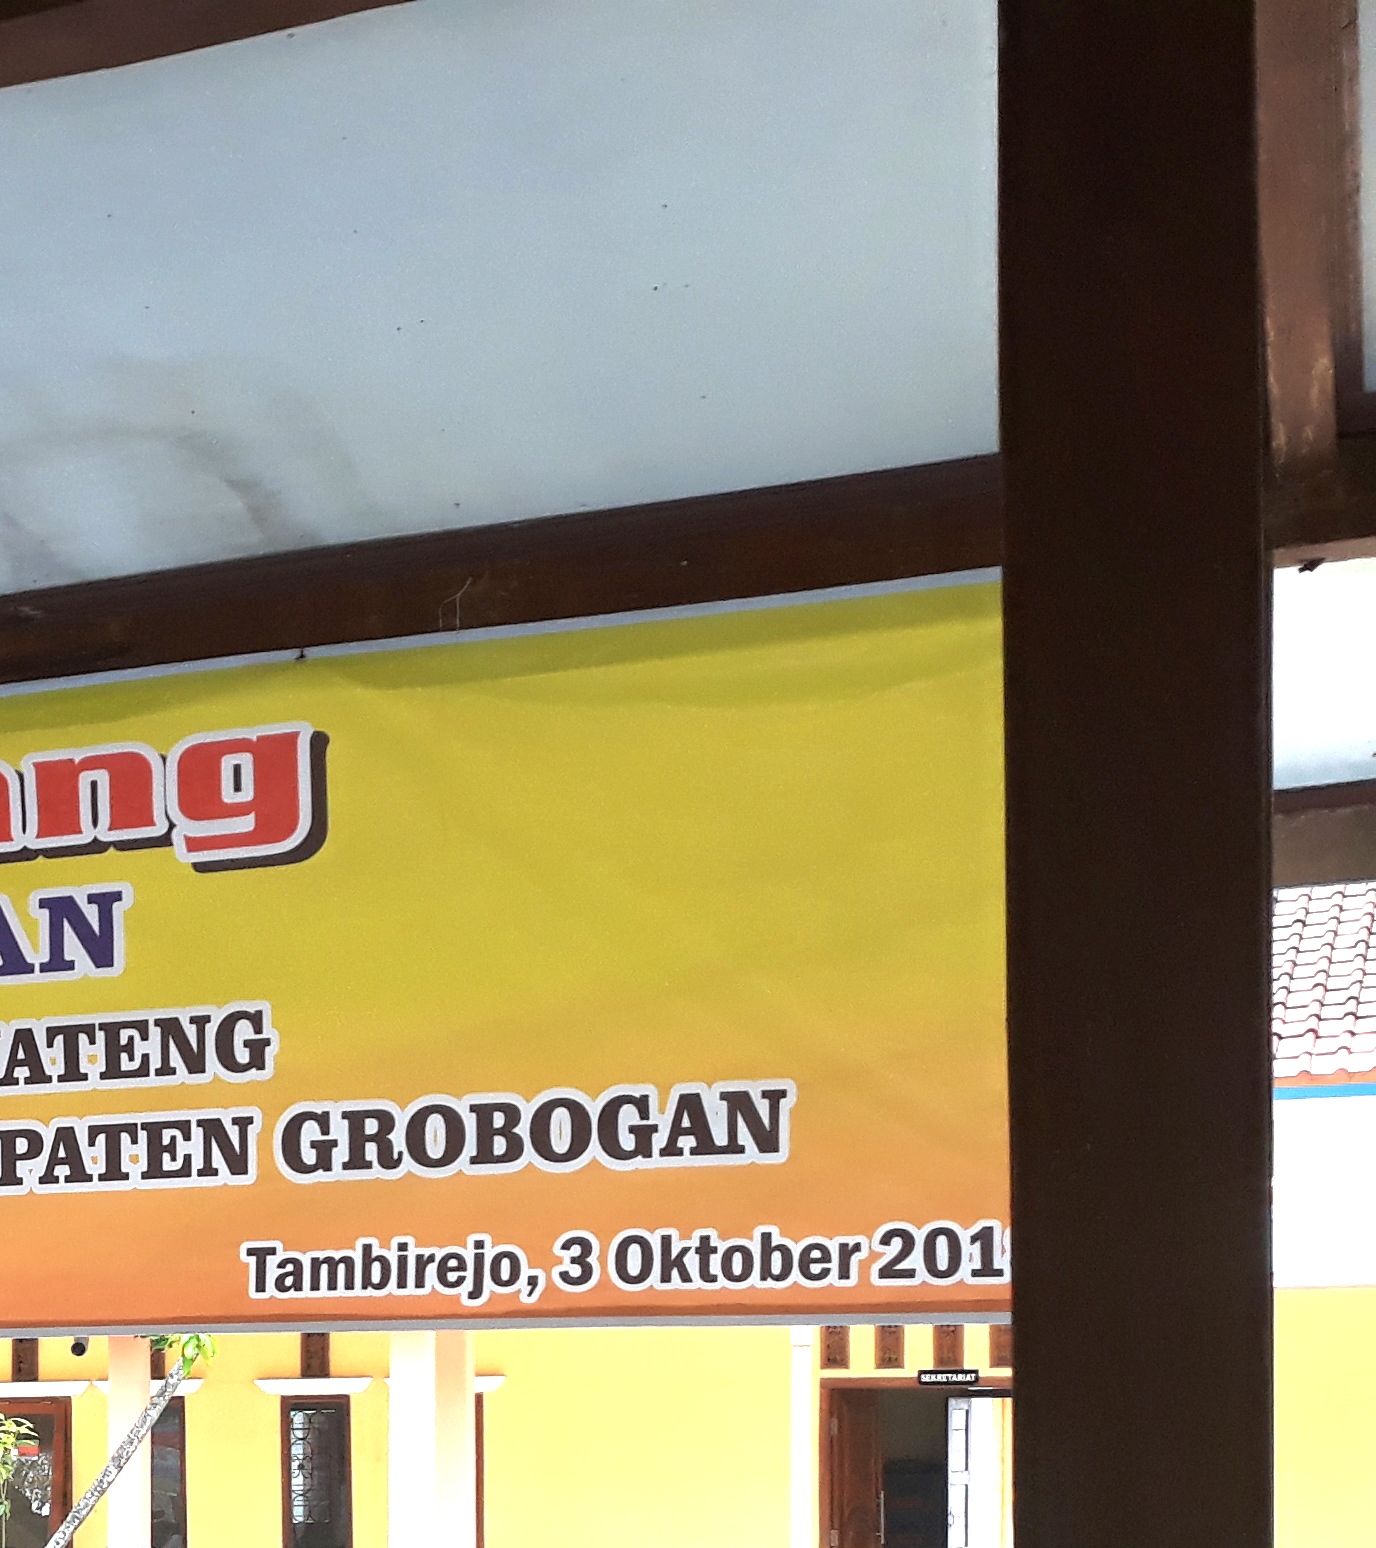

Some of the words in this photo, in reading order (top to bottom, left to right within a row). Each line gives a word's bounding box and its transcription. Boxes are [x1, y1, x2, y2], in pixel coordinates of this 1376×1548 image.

[279, 1087, 789, 1176] GROBOGAN
[246, 1238, 540, 1300] Tambirejo,
[558, 1235, 596, 1286] 3
[615, 1230, 863, 1285] Oktober
[877, 1225, 1011, 1280] 201
[920, 1373, 976, 1383] SEKRETARIAT
